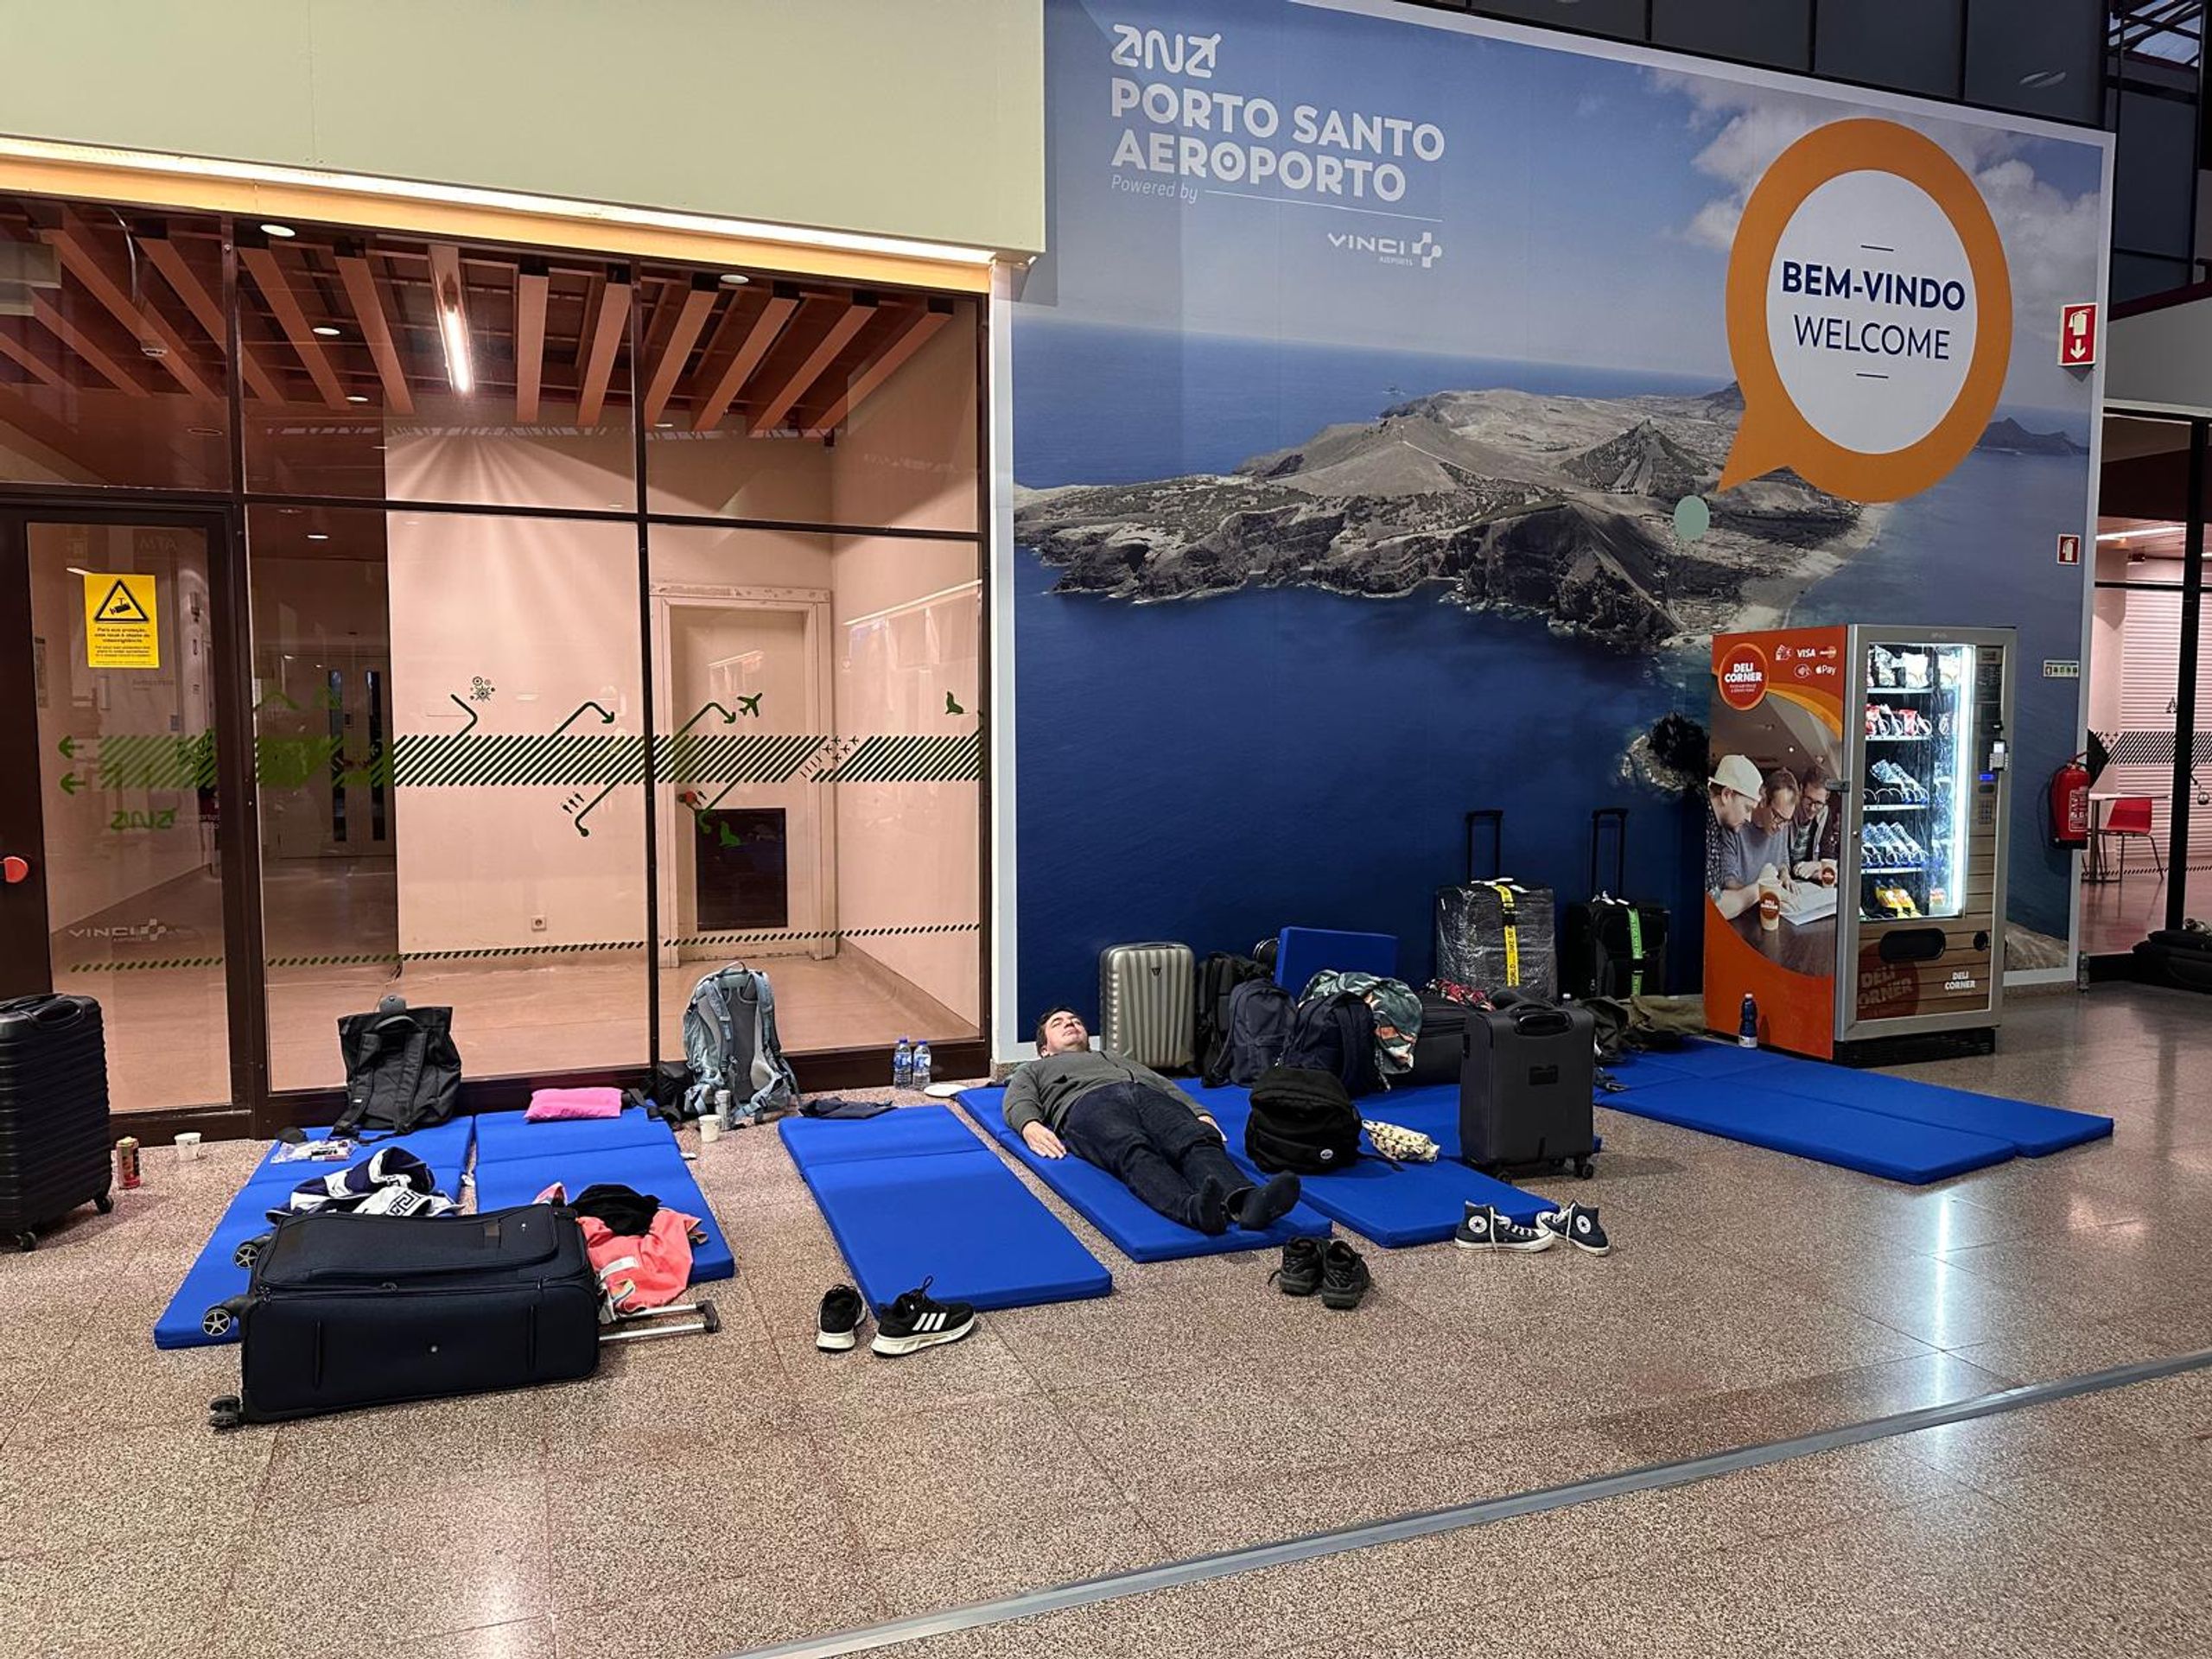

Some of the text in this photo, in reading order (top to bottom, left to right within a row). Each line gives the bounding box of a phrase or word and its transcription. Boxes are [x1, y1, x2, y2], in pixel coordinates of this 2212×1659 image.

[1111, 77, 1446, 162] PORTO SANTO
[1111, 129, 1406, 201] AEROPORTO
[1111, 175, 1198, 204] Powered by
[1327, 232, 1405, 255] VINCI
[1782, 261, 1966, 311] BEM-VINDO
[1794, 314, 1951, 359] WELCOME
[1796, 648, 1816, 658] VISA
[1725, 671, 1763, 683] CORNER
[1733, 662, 1754, 672] DELI
[1821, 664, 1837, 676] Pay
[69, 926, 135, 938] VINCI
[1860, 964, 1896, 988] DELI
[1945, 980, 1976, 990] CORNER
[1952, 971, 1969, 980] DELI
[1858, 978, 1914, 1006] ORNER
